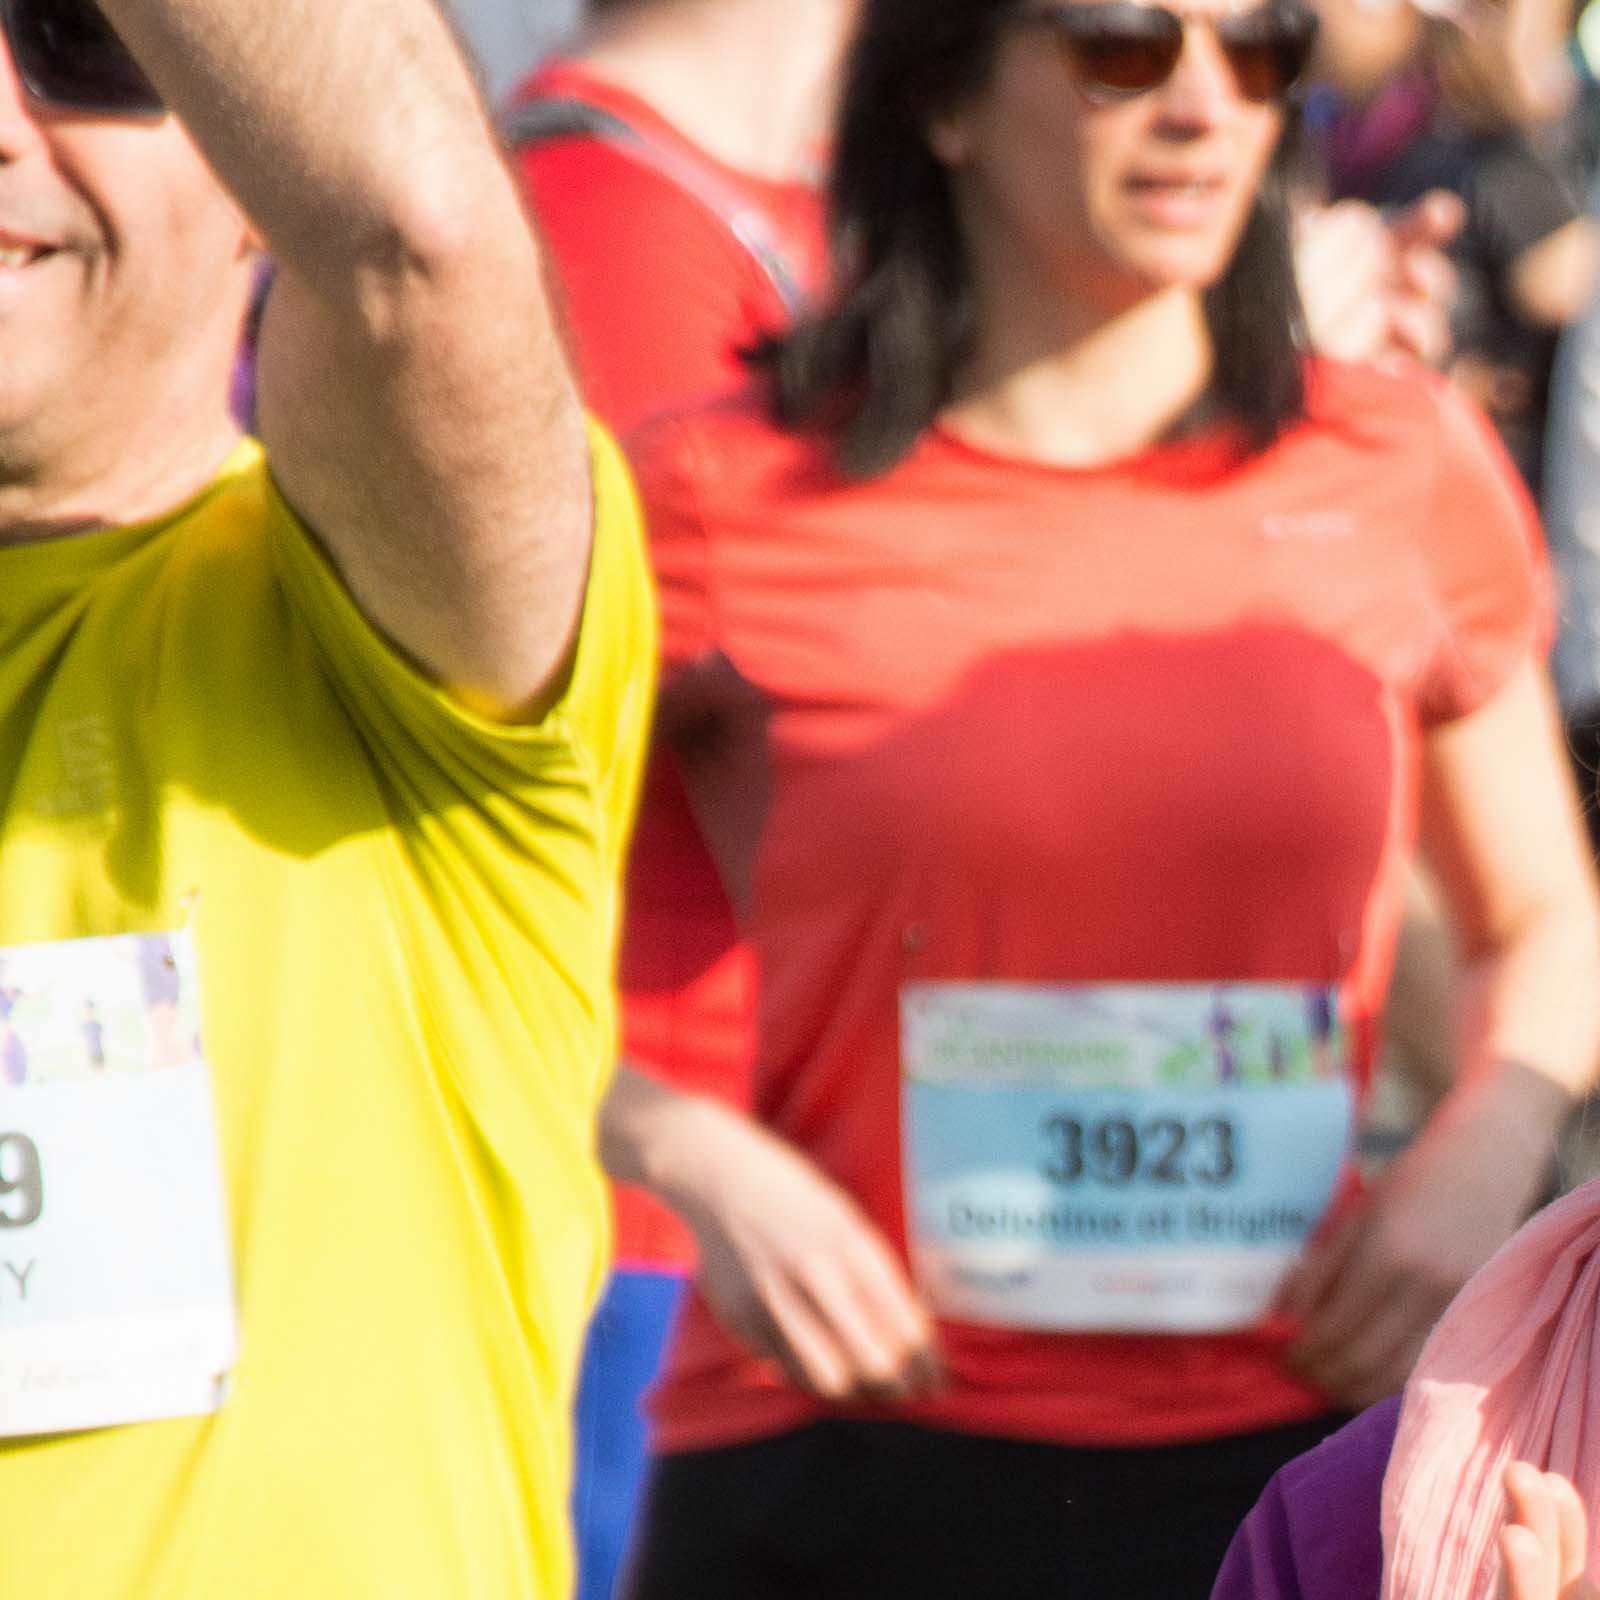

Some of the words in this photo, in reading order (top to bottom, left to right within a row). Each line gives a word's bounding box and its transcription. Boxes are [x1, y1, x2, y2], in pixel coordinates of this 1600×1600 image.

[0, 1133, 43, 1229] 9
[1042, 1116, 1235, 1184] 3923
[3, 1259, 36, 1298] Y
